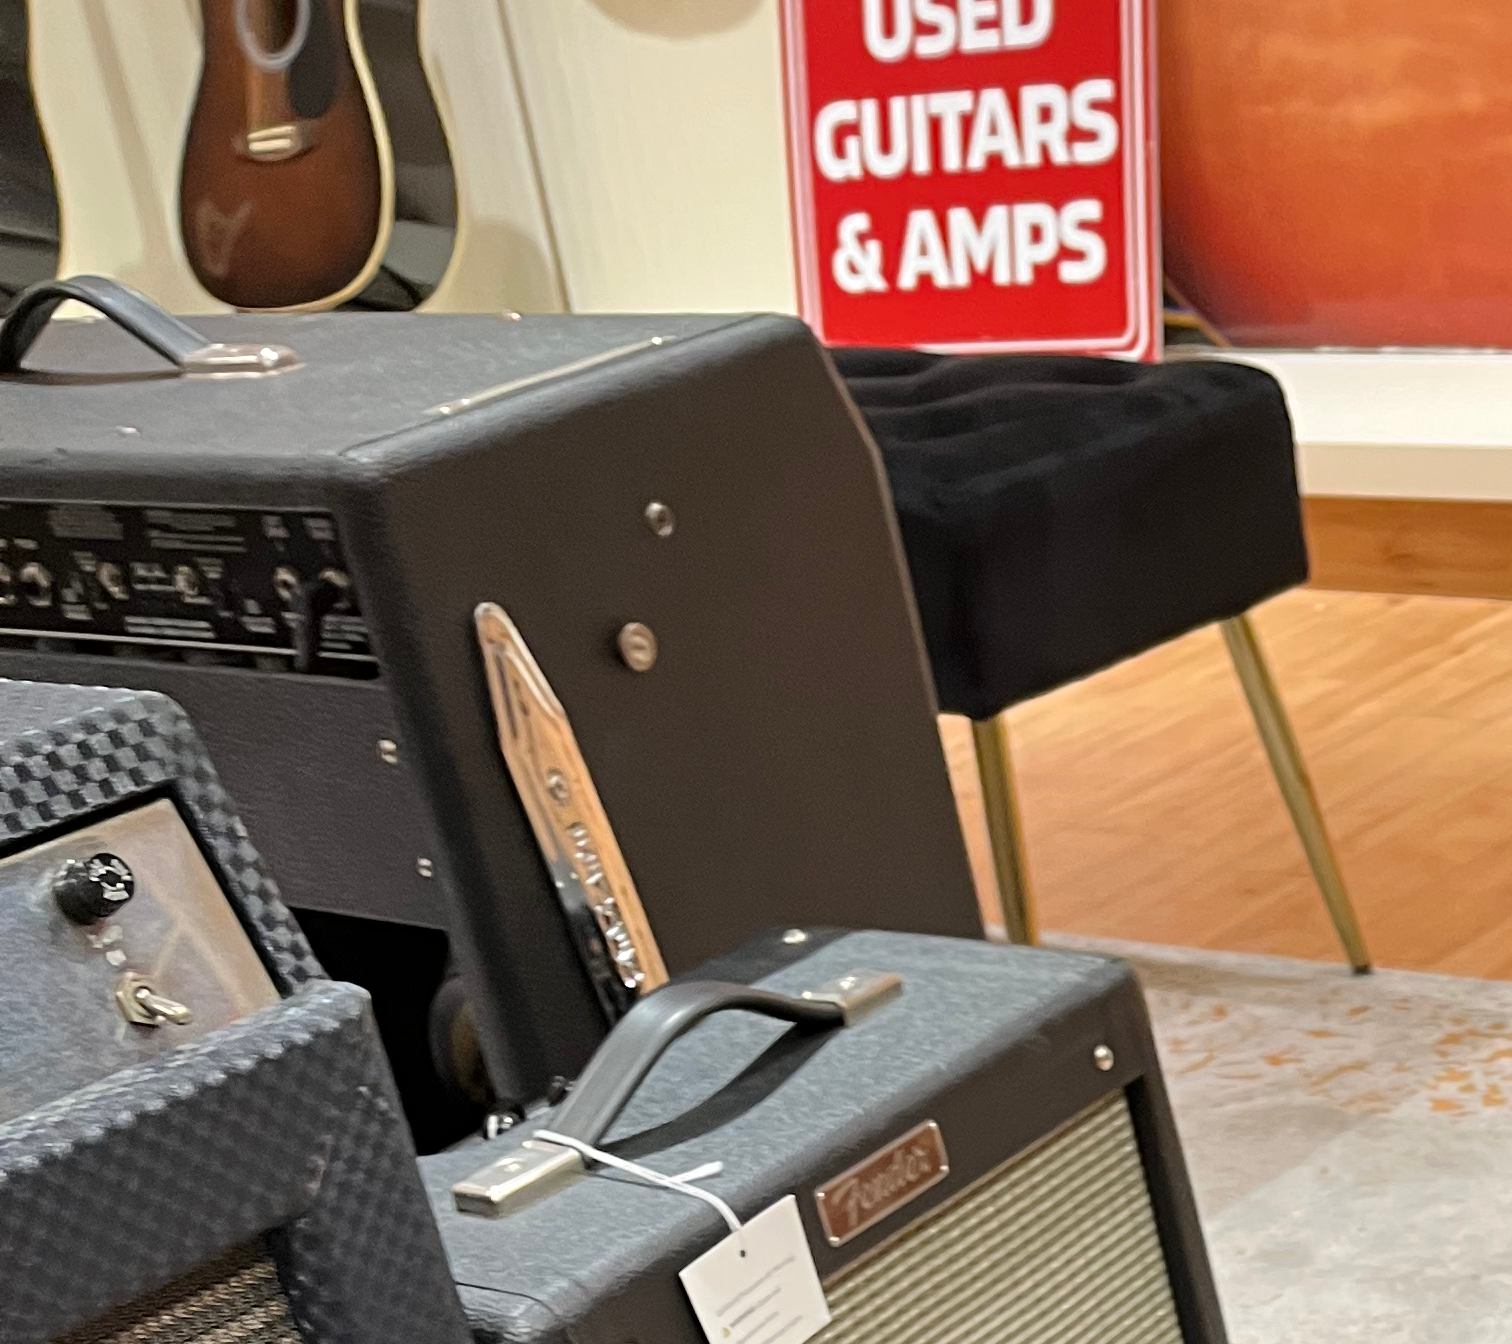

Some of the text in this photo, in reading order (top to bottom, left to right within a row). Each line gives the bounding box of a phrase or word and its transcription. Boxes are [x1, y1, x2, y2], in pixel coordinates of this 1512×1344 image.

[862, 0, 1054, 62] USED
[813, 79, 1119, 182] GUITARS
[831, 198, 1107, 293] & AMPS
[830, 1145, 932, 1226] Fender
